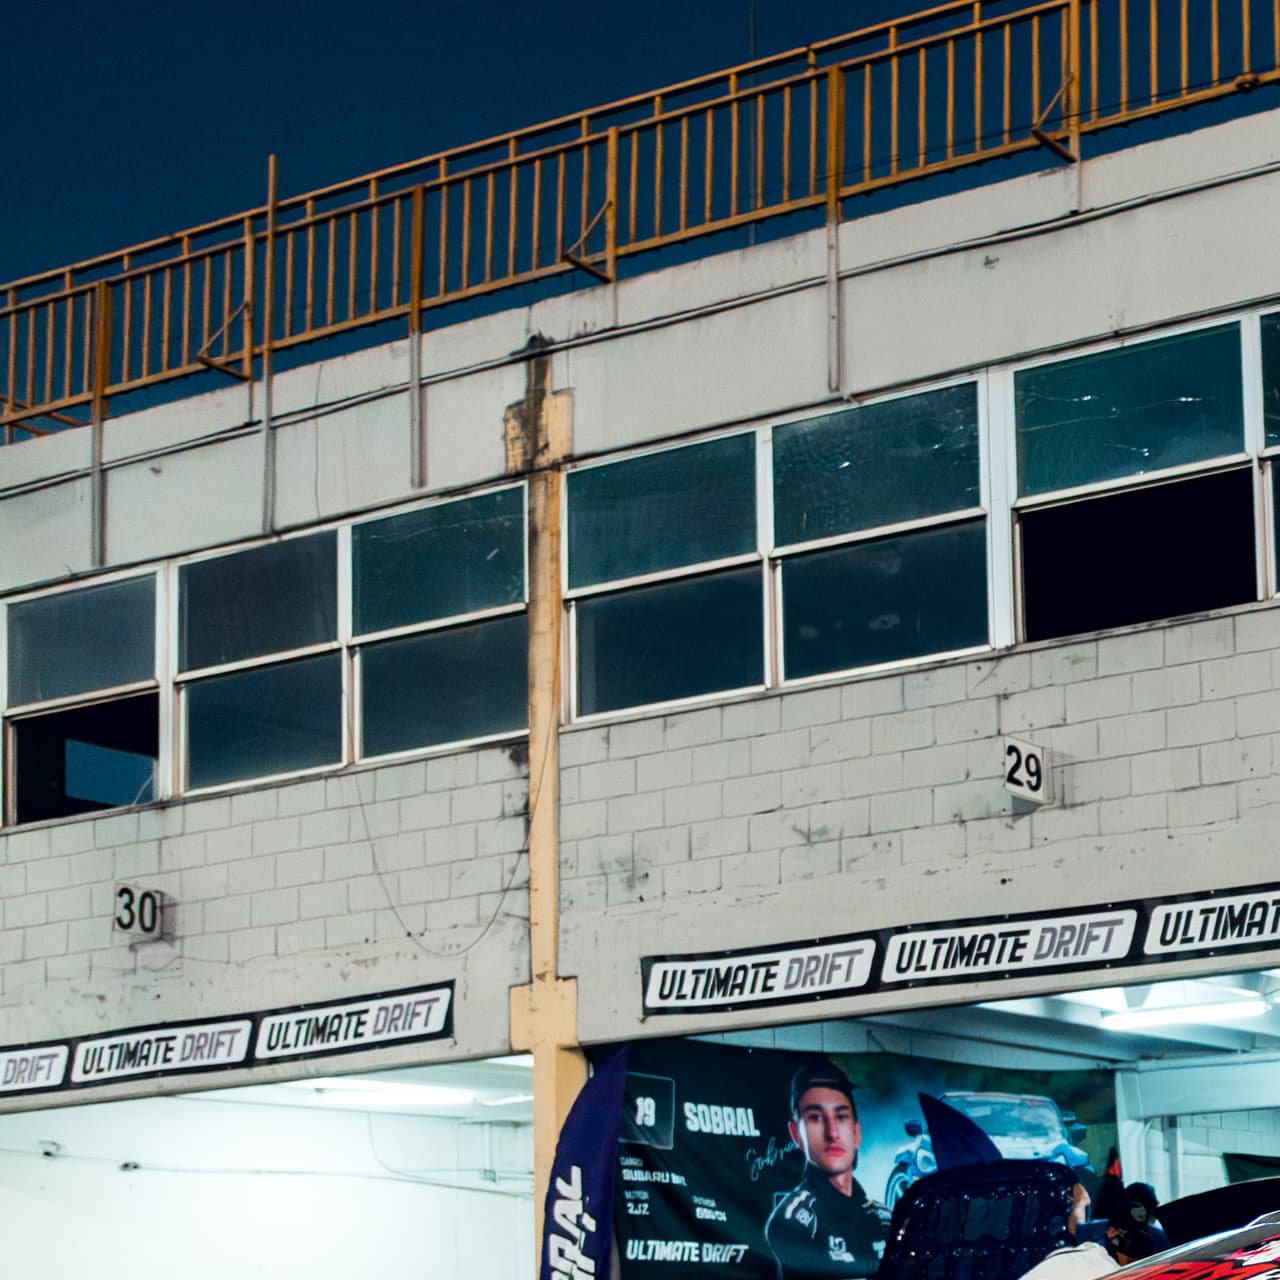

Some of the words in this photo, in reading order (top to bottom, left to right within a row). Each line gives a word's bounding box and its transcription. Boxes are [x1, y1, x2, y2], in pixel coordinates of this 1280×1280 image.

[1006, 744, 1042, 792] 29
[116, 887, 158, 933] 30
[896, 931, 1031, 975] ULTIMATE
[1032, 922, 1124, 961] DRIFT
[659, 963, 778, 1001] ULTIMATE
[785, 949, 864, 987] DRIFT
[266, 1009, 370, 1052] ULTIMATE
[372, 996, 440, 1036] DRIFT
[2, 1053, 60, 1086] DRIFT
[82, 1034, 178, 1075] ULTIMATE
[179, 1028, 242, 1062] DRIFT
[635, 1096, 656, 1128] 19
[683, 1101, 761, 1137] SOBRAL
[621, 1168, 670, 1184] SUBARU
[626, 1239, 700, 1262] ULTIMATE
[701, 1242, 749, 1264] DRIFT
